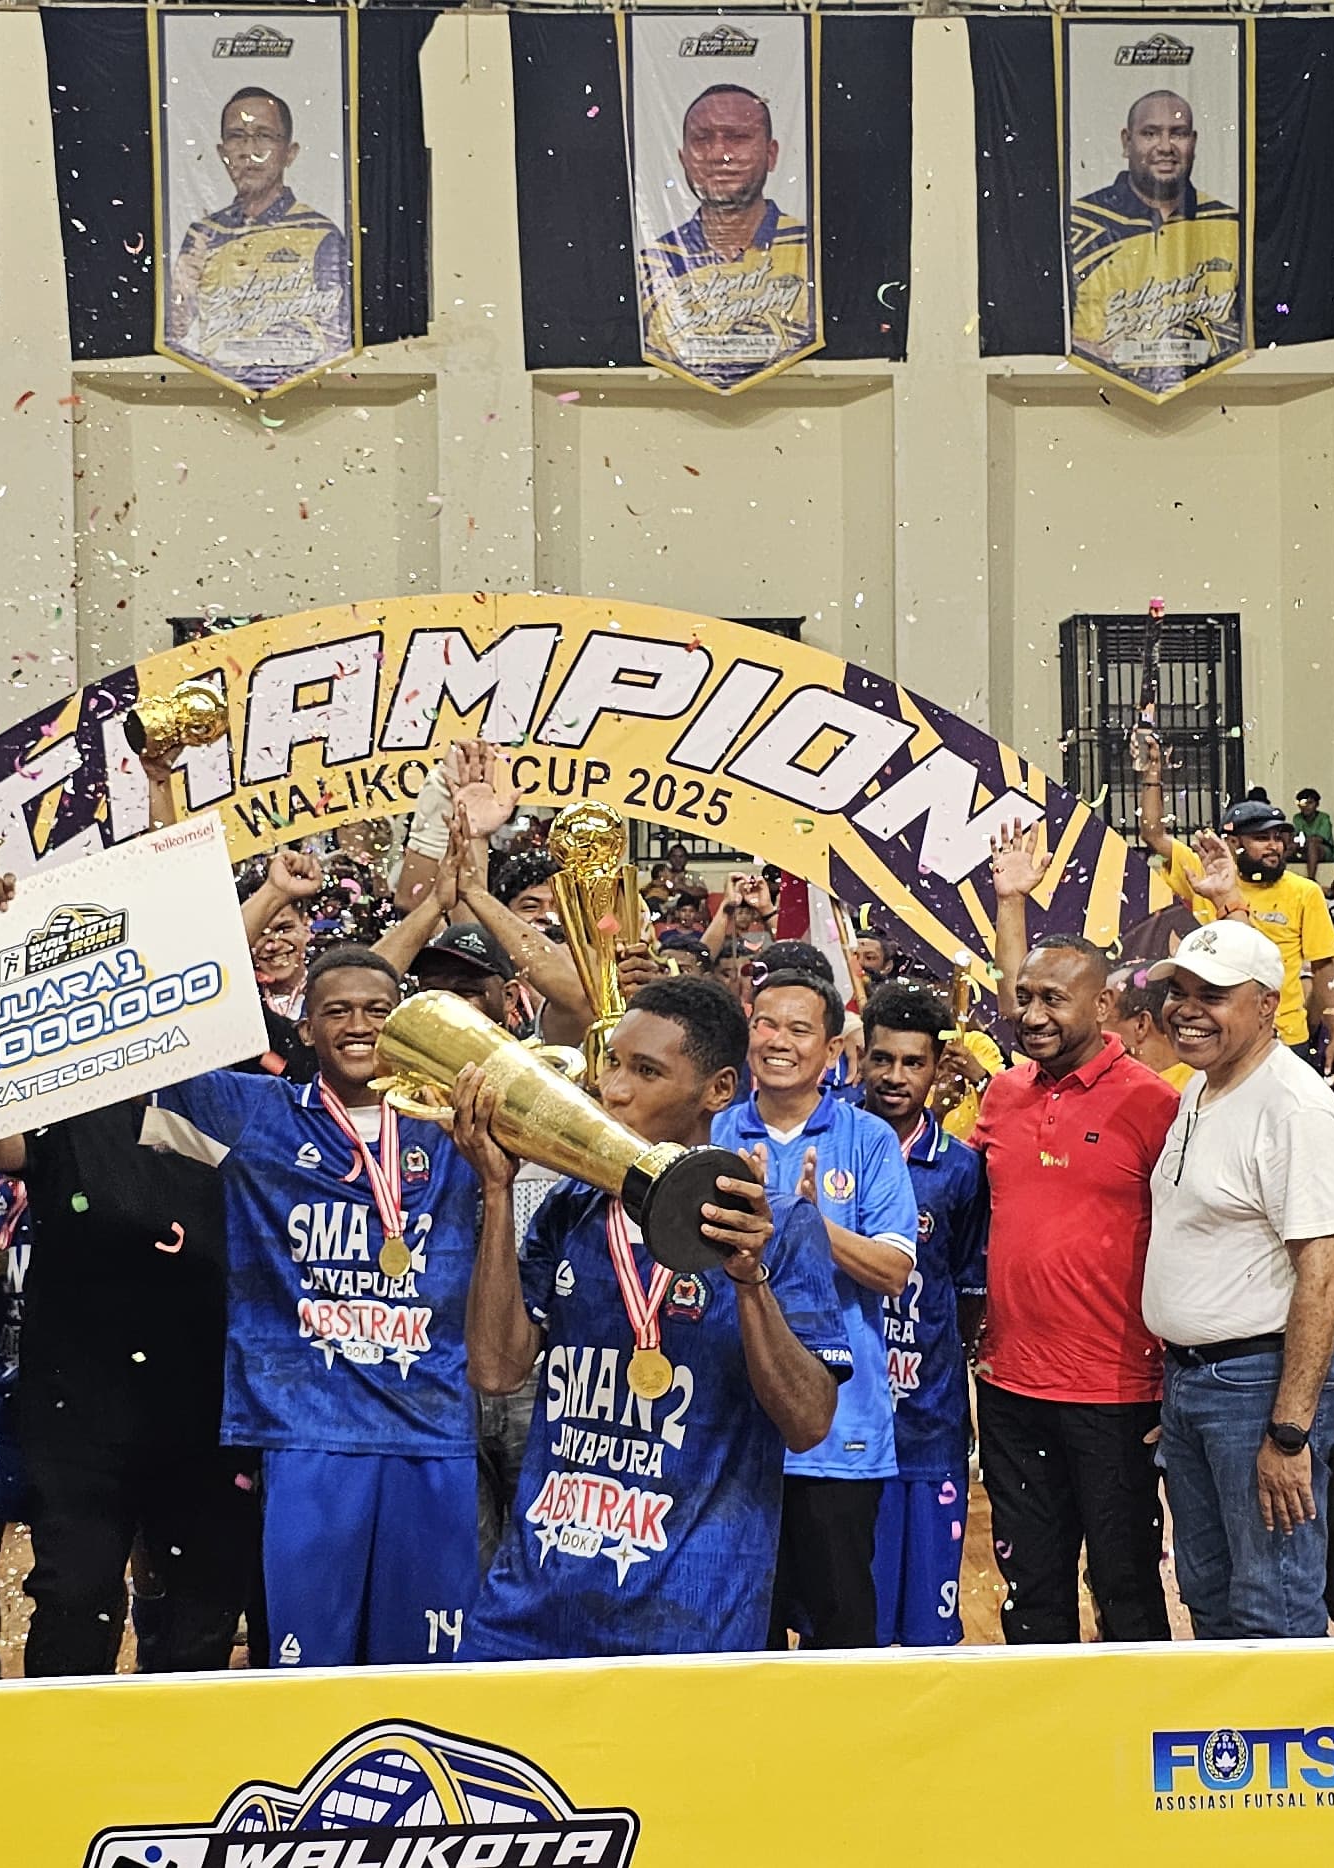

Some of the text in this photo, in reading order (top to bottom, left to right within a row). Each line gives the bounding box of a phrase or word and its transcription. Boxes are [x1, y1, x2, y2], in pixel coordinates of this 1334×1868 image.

[1107, 264, 1206, 311] Selamat
[1103, 290, 1238, 343] Bertanding
[511, 757, 610, 798] CUP
[624, 766, 733, 826] 2025
[149, 822, 215, 854] Telkomsel
[28, 913, 123, 955] WALIKOTA
[29, 926, 122, 967] CUP 2025
[126, 1025, 190, 1065] SMA
[287, 1203, 370, 1264] SMA
[301, 1266, 420, 1299] JAYAPURA
[302, 1300, 431, 1348] ABSTRAK
[346, 1346, 370, 1360] DOK
[546, 1345, 615, 1422] SMA
[662, 1365, 694, 1450] 2
[551, 1428, 664, 1479] JAYAPURA
[534, 1477, 668, 1545] ABSTRAK
[561, 1530, 587, 1550] DOK
[425, 1609, 464, 1655] 14
[1155, 1794, 1236, 1812] ASOSIASI
[1244, 1791, 1307, 1809] FUTSAL
[224, 1830, 614, 1868] WALIKOTA
